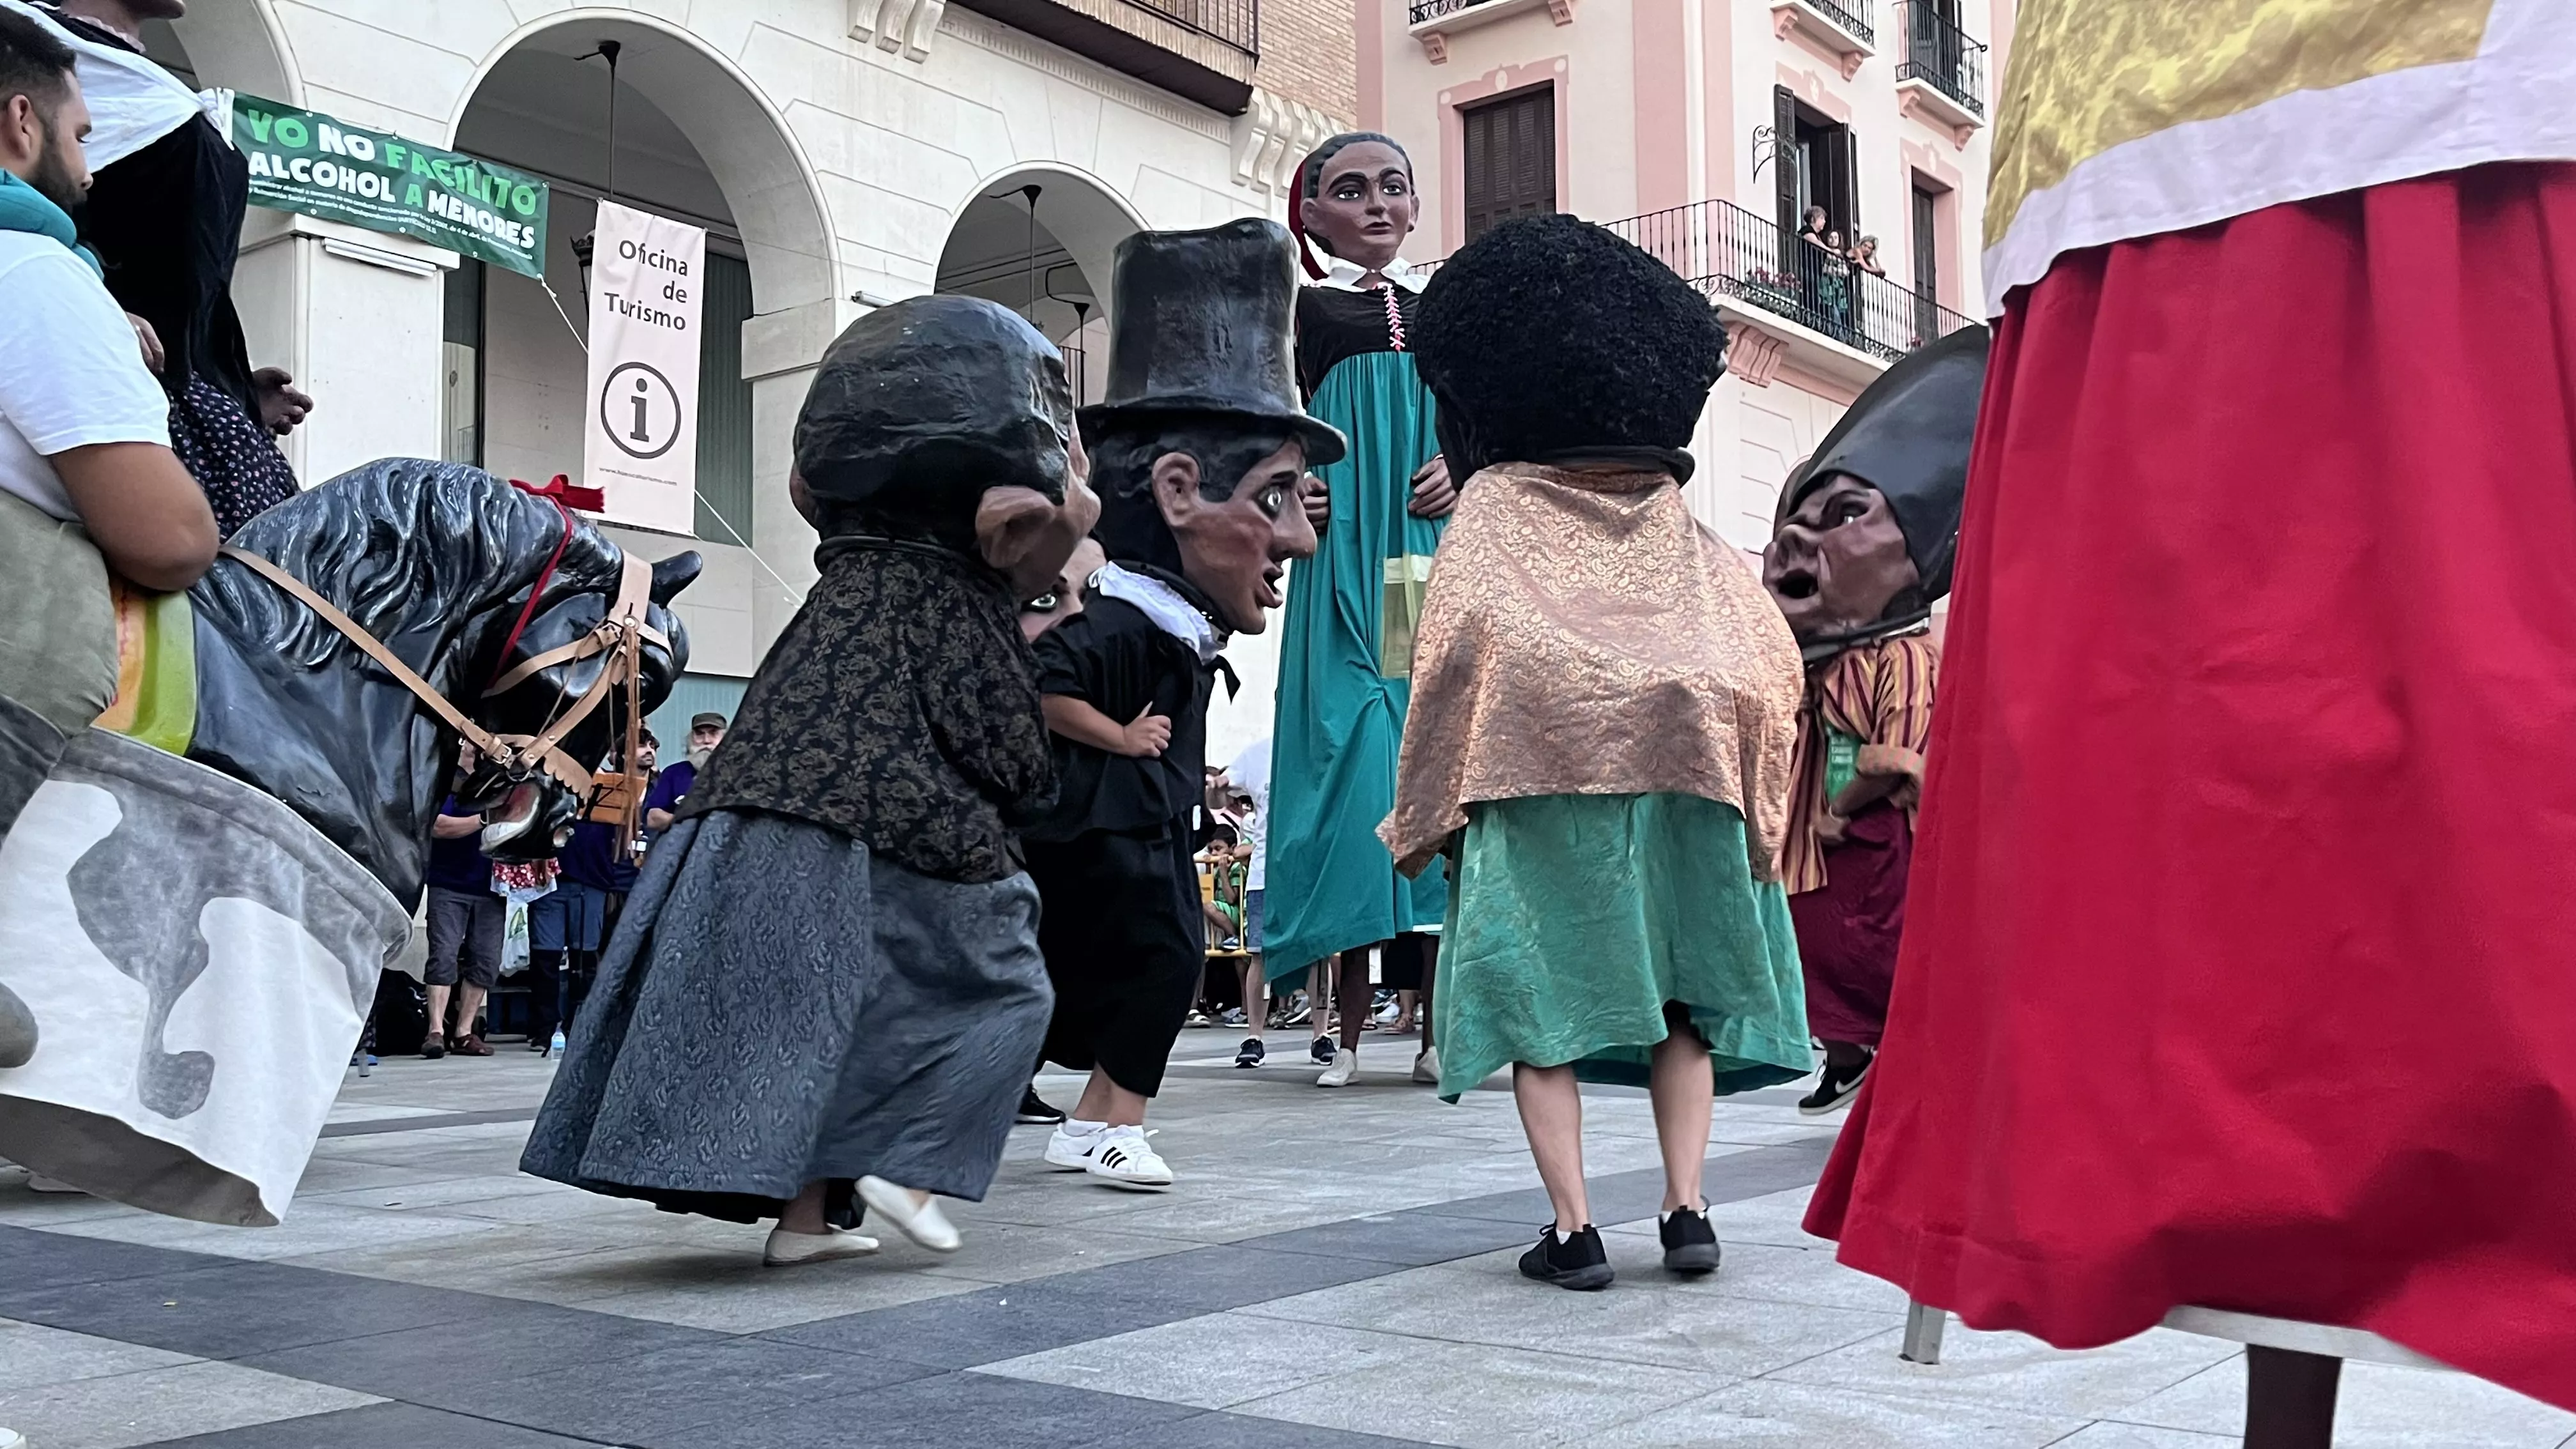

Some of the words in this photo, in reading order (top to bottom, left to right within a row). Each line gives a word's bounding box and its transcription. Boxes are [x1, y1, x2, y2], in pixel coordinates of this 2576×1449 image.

[247, 109, 309, 148] YO
[318, 122, 375, 162] NO
[383, 143, 537, 216] FACILITO
[248, 151, 396, 204] ALCOHOL
[404, 183, 424, 208] A
[427, 189, 536, 249] MENORES
[618, 239, 687, 277] Oficina
[604, 291, 686, 331] Turismo
[663, 280, 687, 303] de
